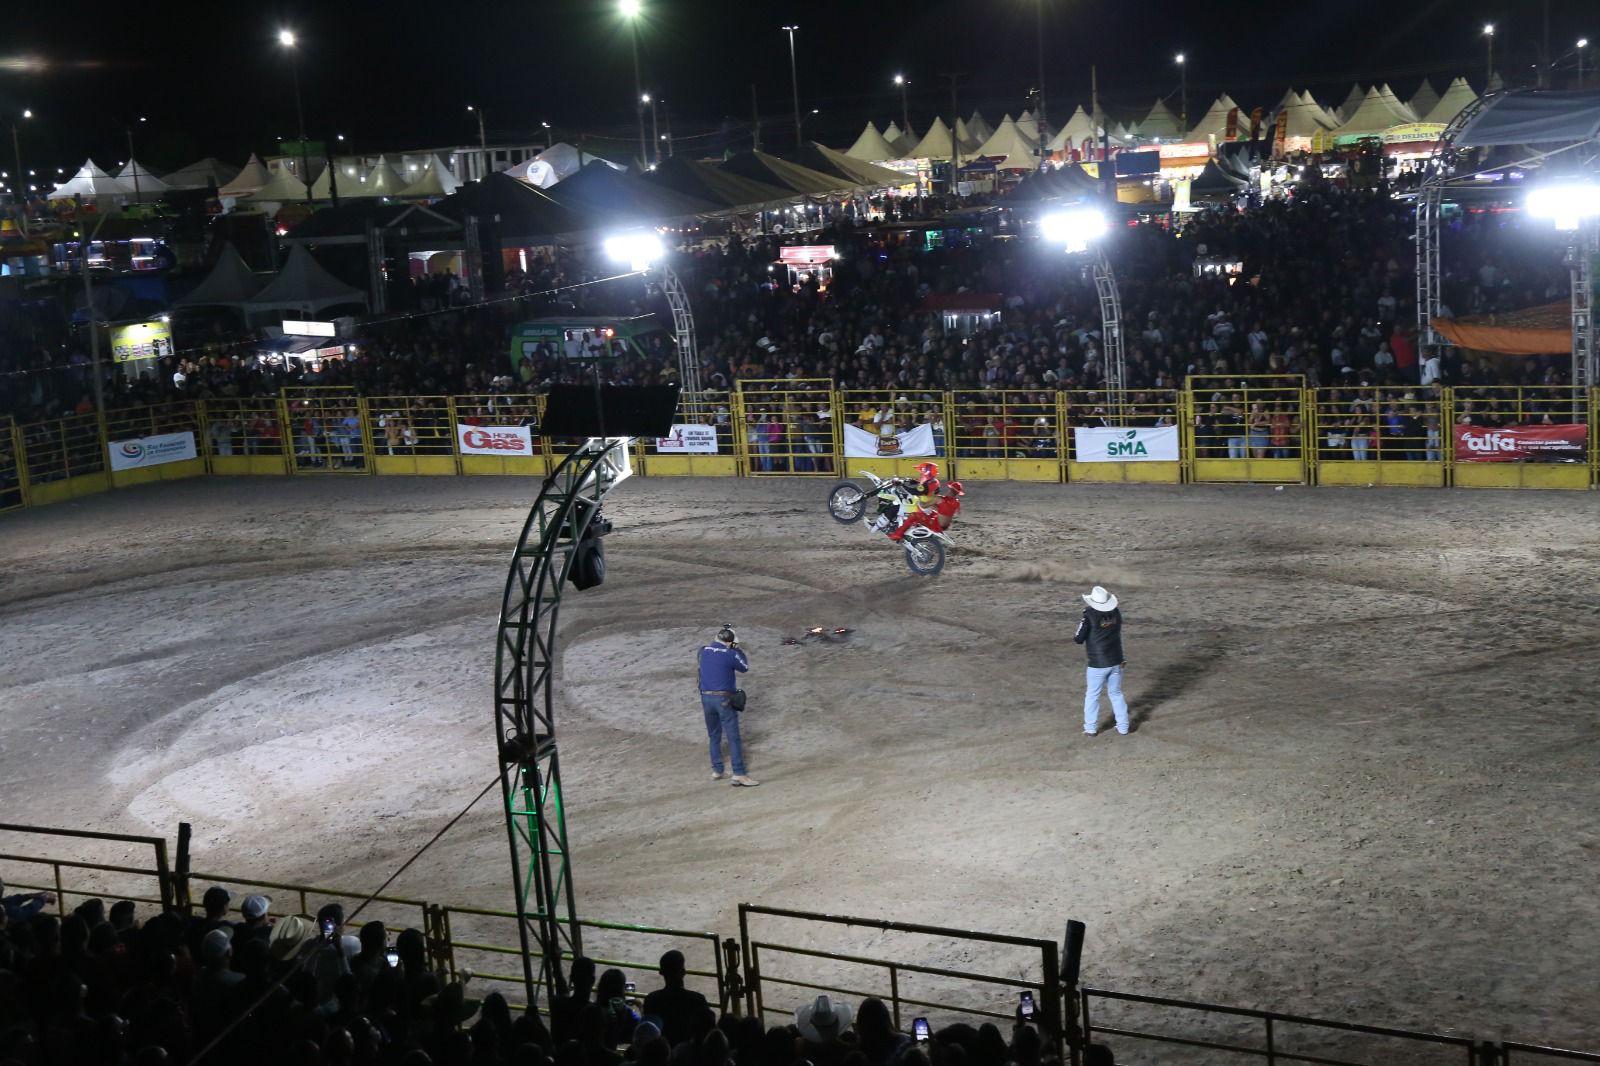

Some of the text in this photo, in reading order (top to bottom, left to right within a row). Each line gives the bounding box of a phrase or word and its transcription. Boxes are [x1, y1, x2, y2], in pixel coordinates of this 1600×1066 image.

[463, 430, 525, 450] Gas
[1107, 440, 1148, 455] SMA
[1467, 433, 1515, 451] alfa
